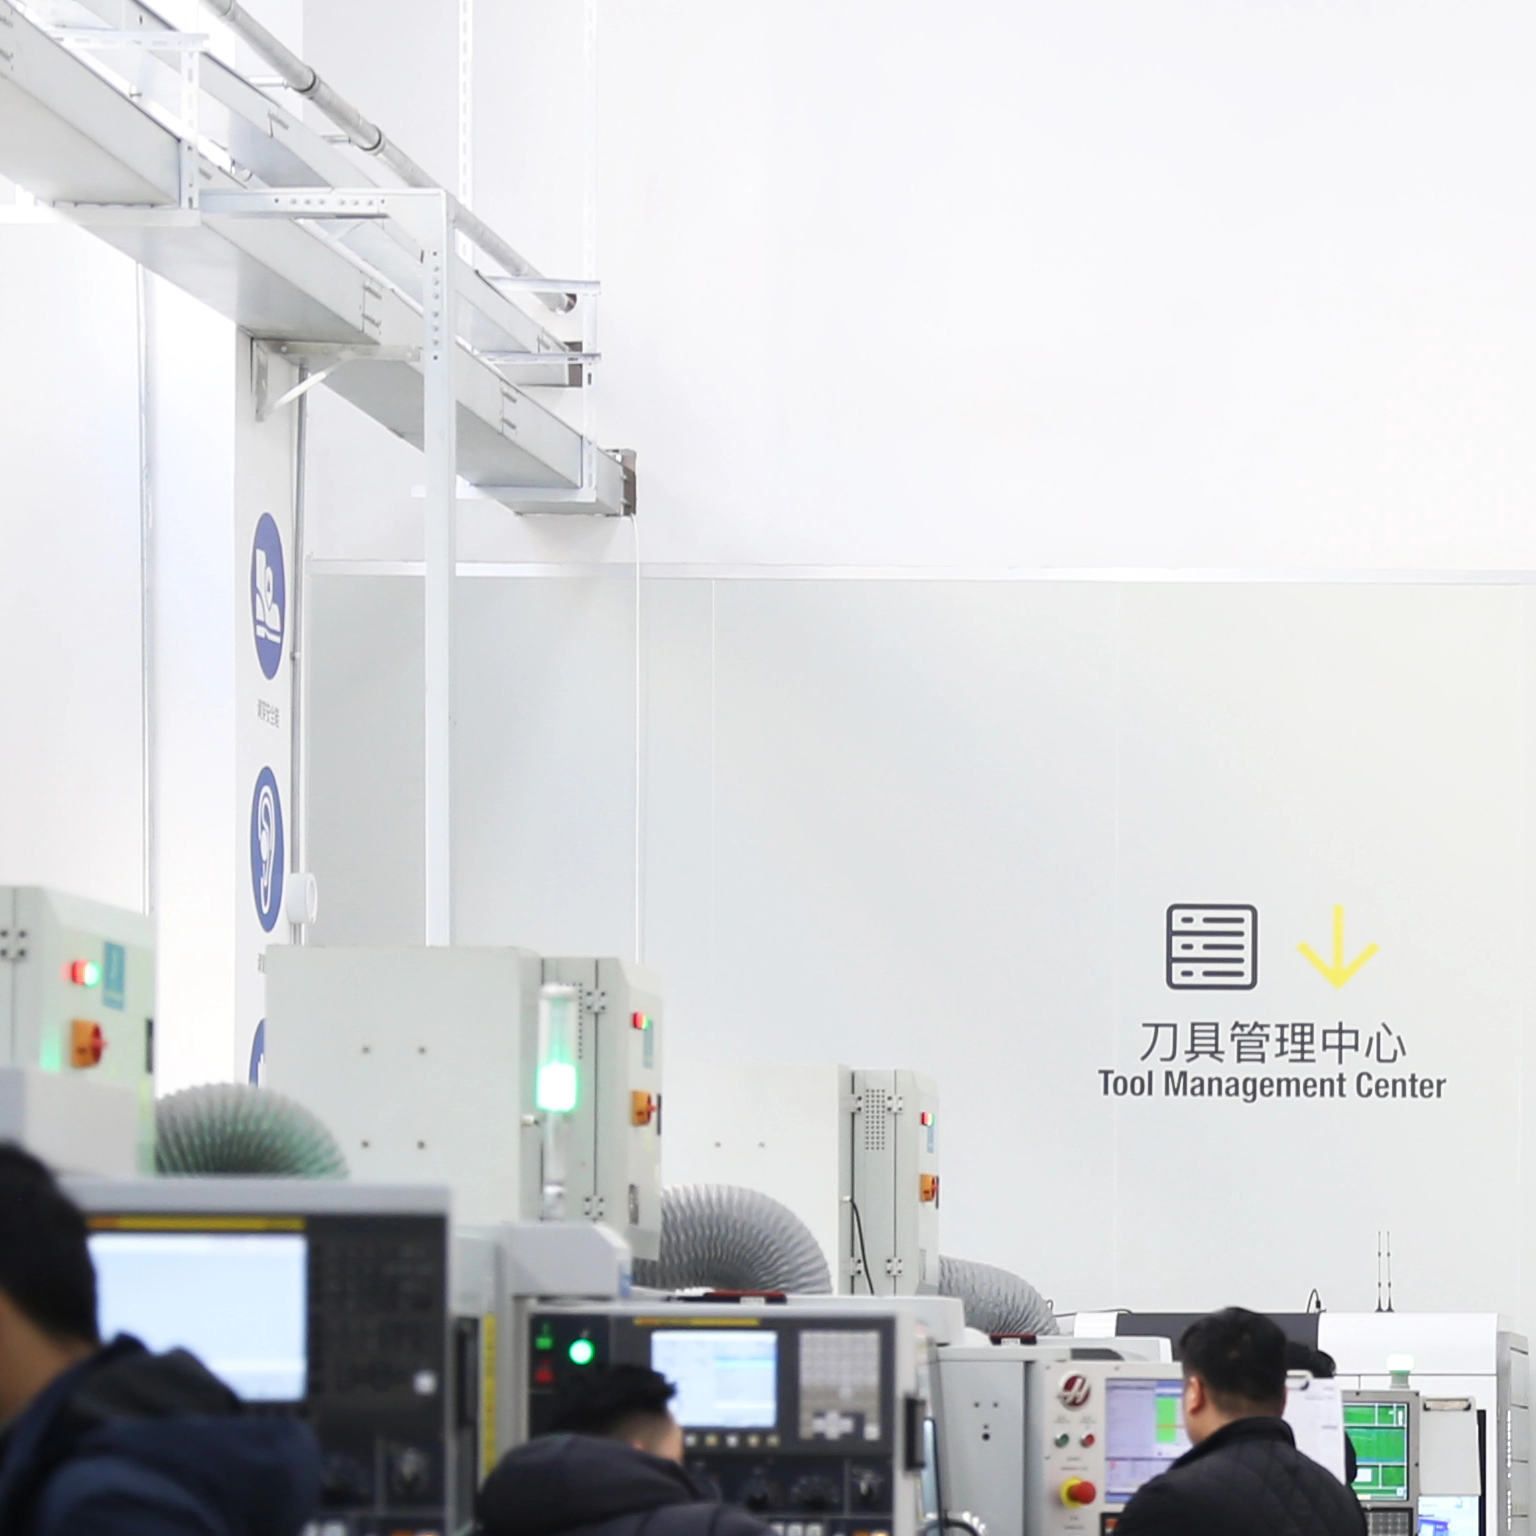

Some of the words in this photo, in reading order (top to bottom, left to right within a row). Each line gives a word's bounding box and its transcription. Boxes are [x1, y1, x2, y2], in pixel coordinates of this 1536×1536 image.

[1139, 1020, 1407, 1066] 刀具管理中心
[1098, 1069, 1154, 1097] Tool
[1164, 1069, 1347, 1104] Management
[1355, 1071, 1447, 1099] Center
